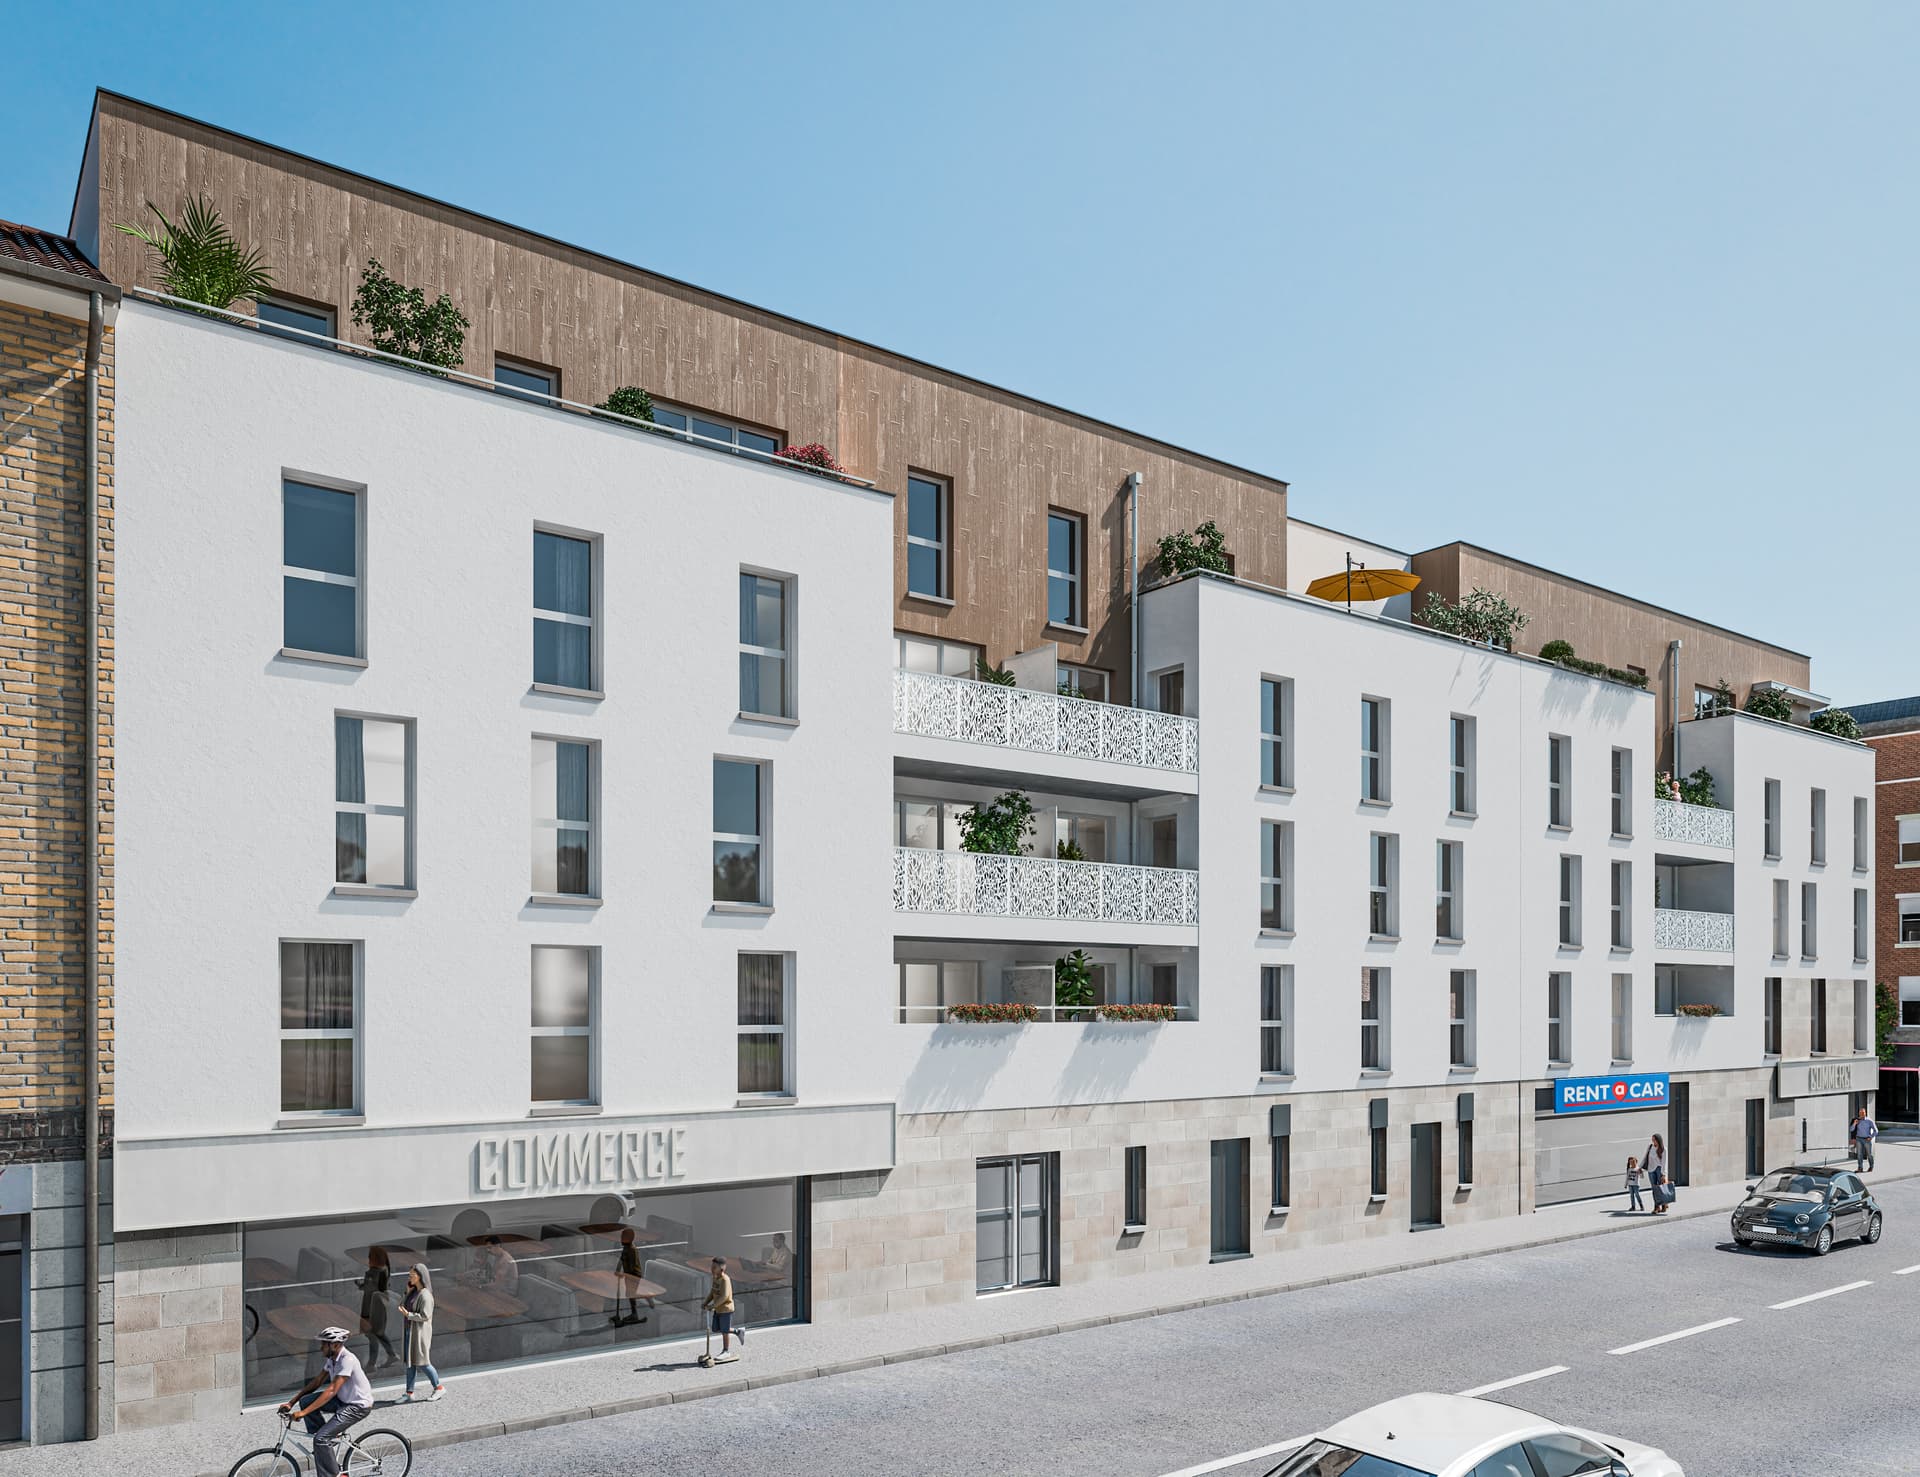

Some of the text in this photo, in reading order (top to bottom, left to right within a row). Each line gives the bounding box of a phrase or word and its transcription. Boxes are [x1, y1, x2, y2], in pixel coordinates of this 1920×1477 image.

[1563, 1084, 1610, 1103] RENT
[1629, 1081, 1665, 1098] CAR
[477, 1126, 688, 1192] COMMERCE
